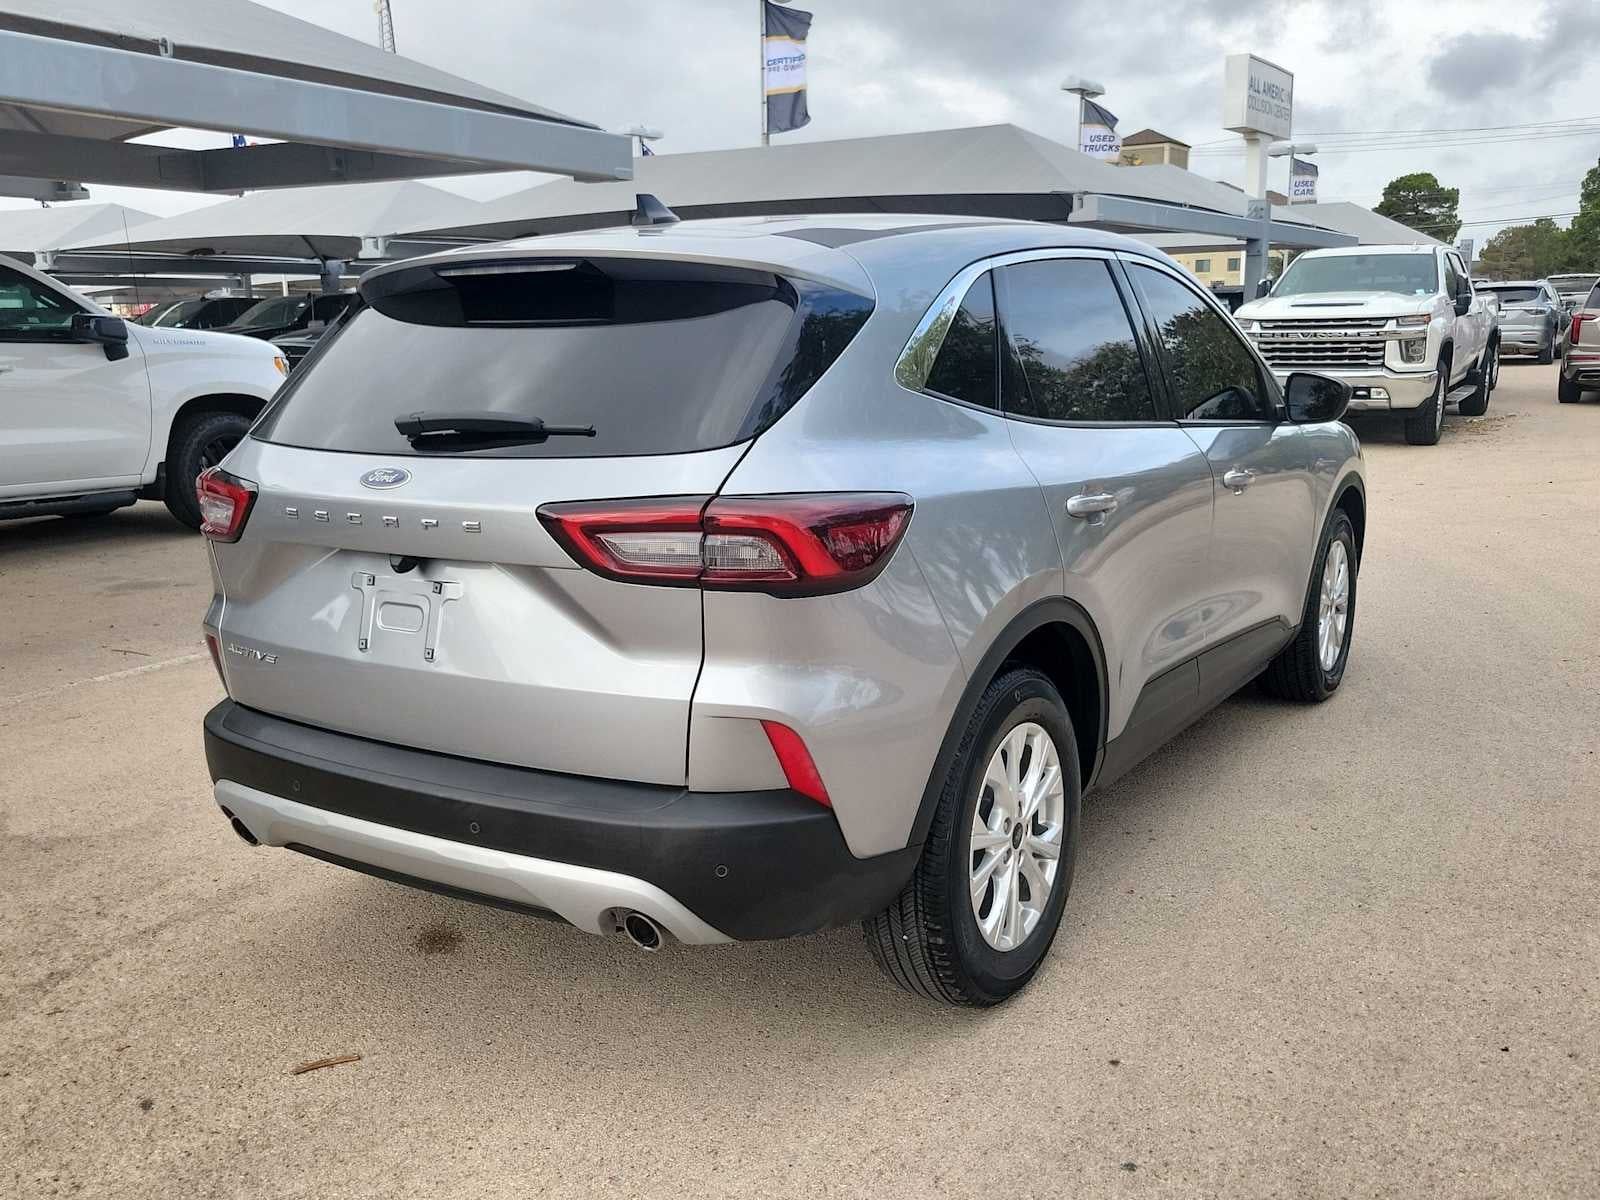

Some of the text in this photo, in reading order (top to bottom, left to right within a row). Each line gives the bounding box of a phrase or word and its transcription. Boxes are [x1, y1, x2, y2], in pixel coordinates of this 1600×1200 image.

[1248, 73, 1291, 105] ALL AMERICN
[1089, 134, 1116, 143] USED
[1083, 144, 1121, 153] TRUCKS
[1294, 180, 1315, 188] USED
[1293, 188, 1314, 196] CARS
[368, 469, 399, 483] Ford
[286, 507, 482, 534] ESCAPE
[228, 643, 279, 665] ACTIVE
